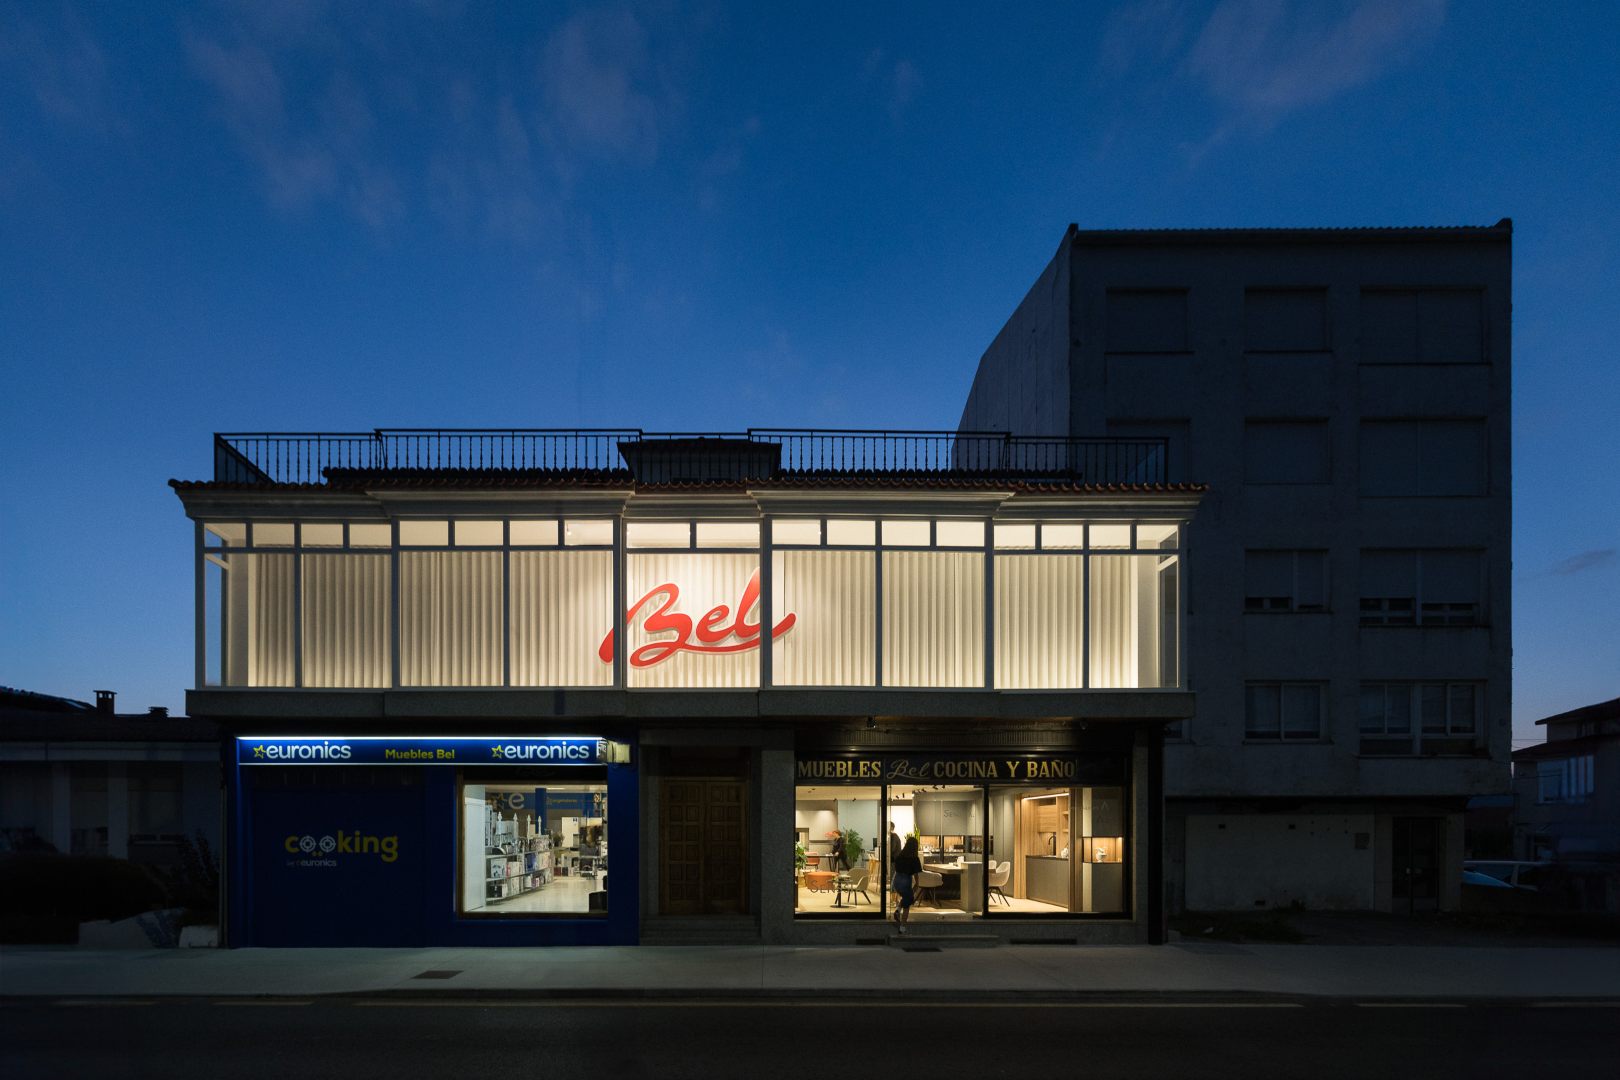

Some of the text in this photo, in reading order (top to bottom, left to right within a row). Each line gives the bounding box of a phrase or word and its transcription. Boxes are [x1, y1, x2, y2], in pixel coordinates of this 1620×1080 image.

[599, 567, 796, 667] Bel
[266, 741, 352, 759] euronics
[385, 748, 455, 760] Muebles Bel
[504, 741, 590, 760] euronics
[797, 759, 1073, 780] MUEBLES Bel COCINA Y BAÑO
[284, 830, 399, 863] cooking
[301, 858, 338, 867] euronics
